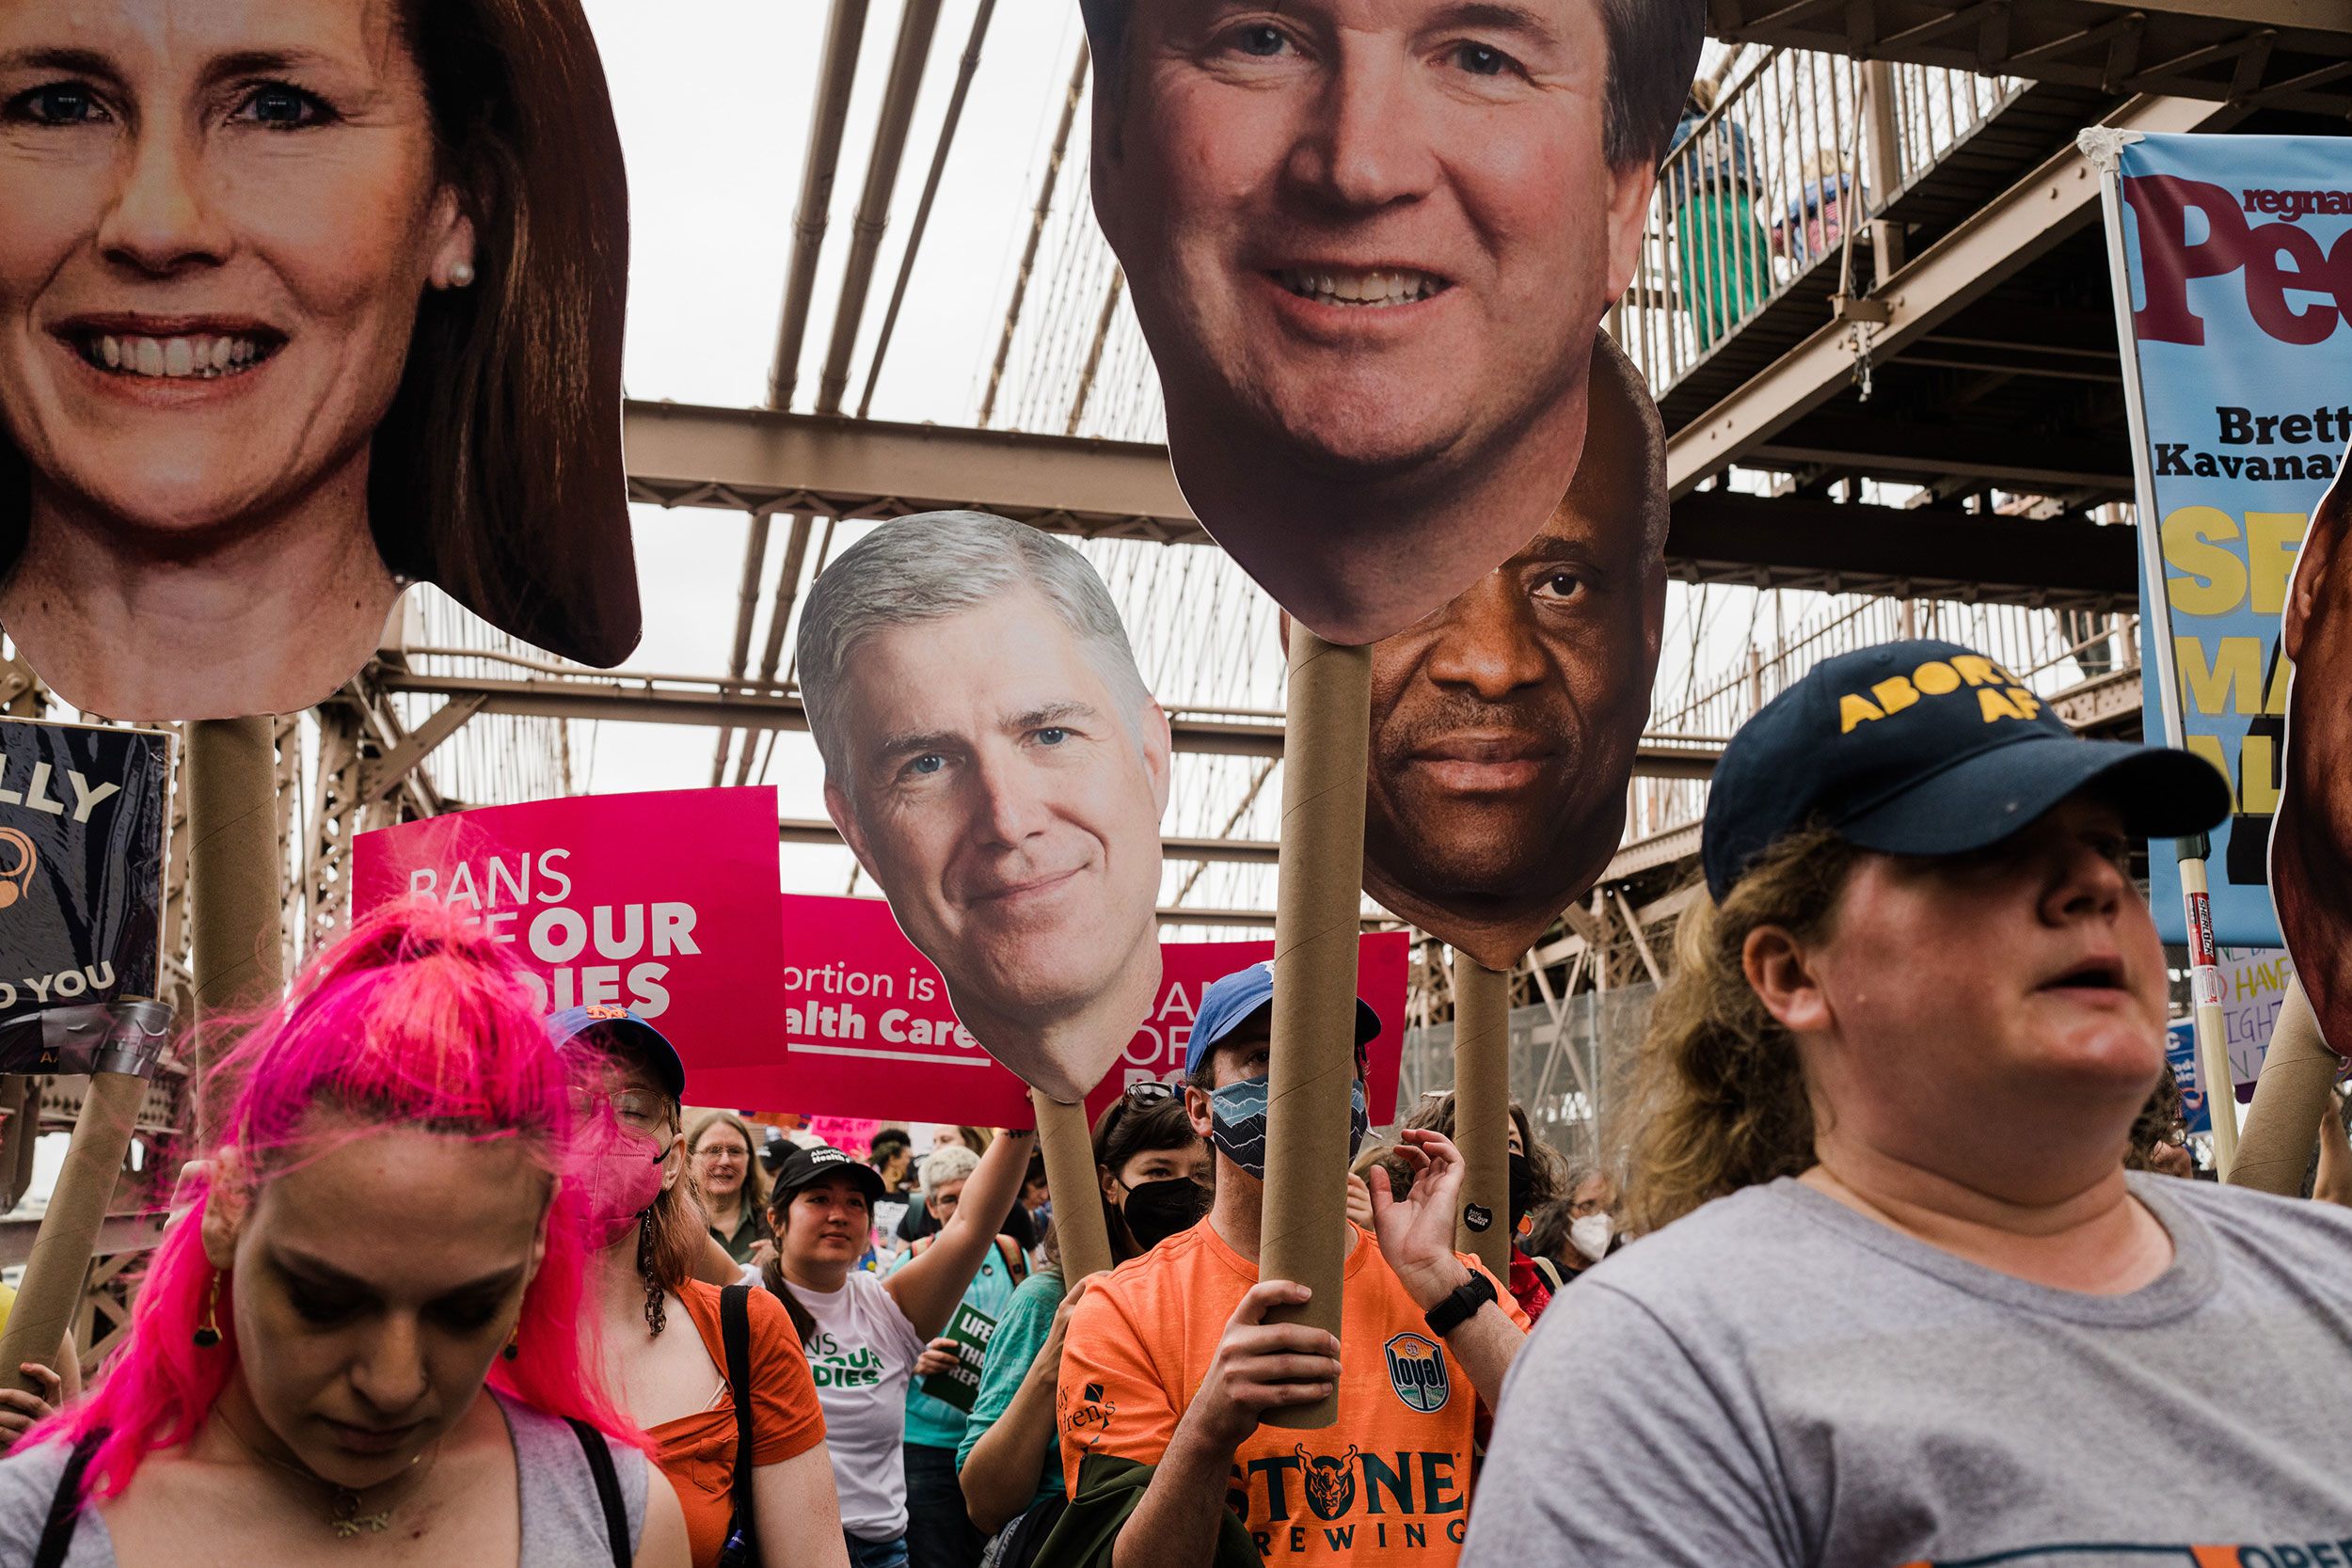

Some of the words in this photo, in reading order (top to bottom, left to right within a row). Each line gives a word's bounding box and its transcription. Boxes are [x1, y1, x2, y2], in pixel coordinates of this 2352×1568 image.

[2216, 405, 2352, 445] Brett
[2154, 443, 2344, 481] Kavana
[528, 902, 702, 963] OUR
[2197, 896, 2215, 958] SHERLOCK
[24, 960, 116, 1003] YOU
[908, 967, 935, 1002] is
[879, 1008, 977, 1049] Care
[960, 1312, 994, 1343] LIFE
[948, 1366, 981, 1391] REP
